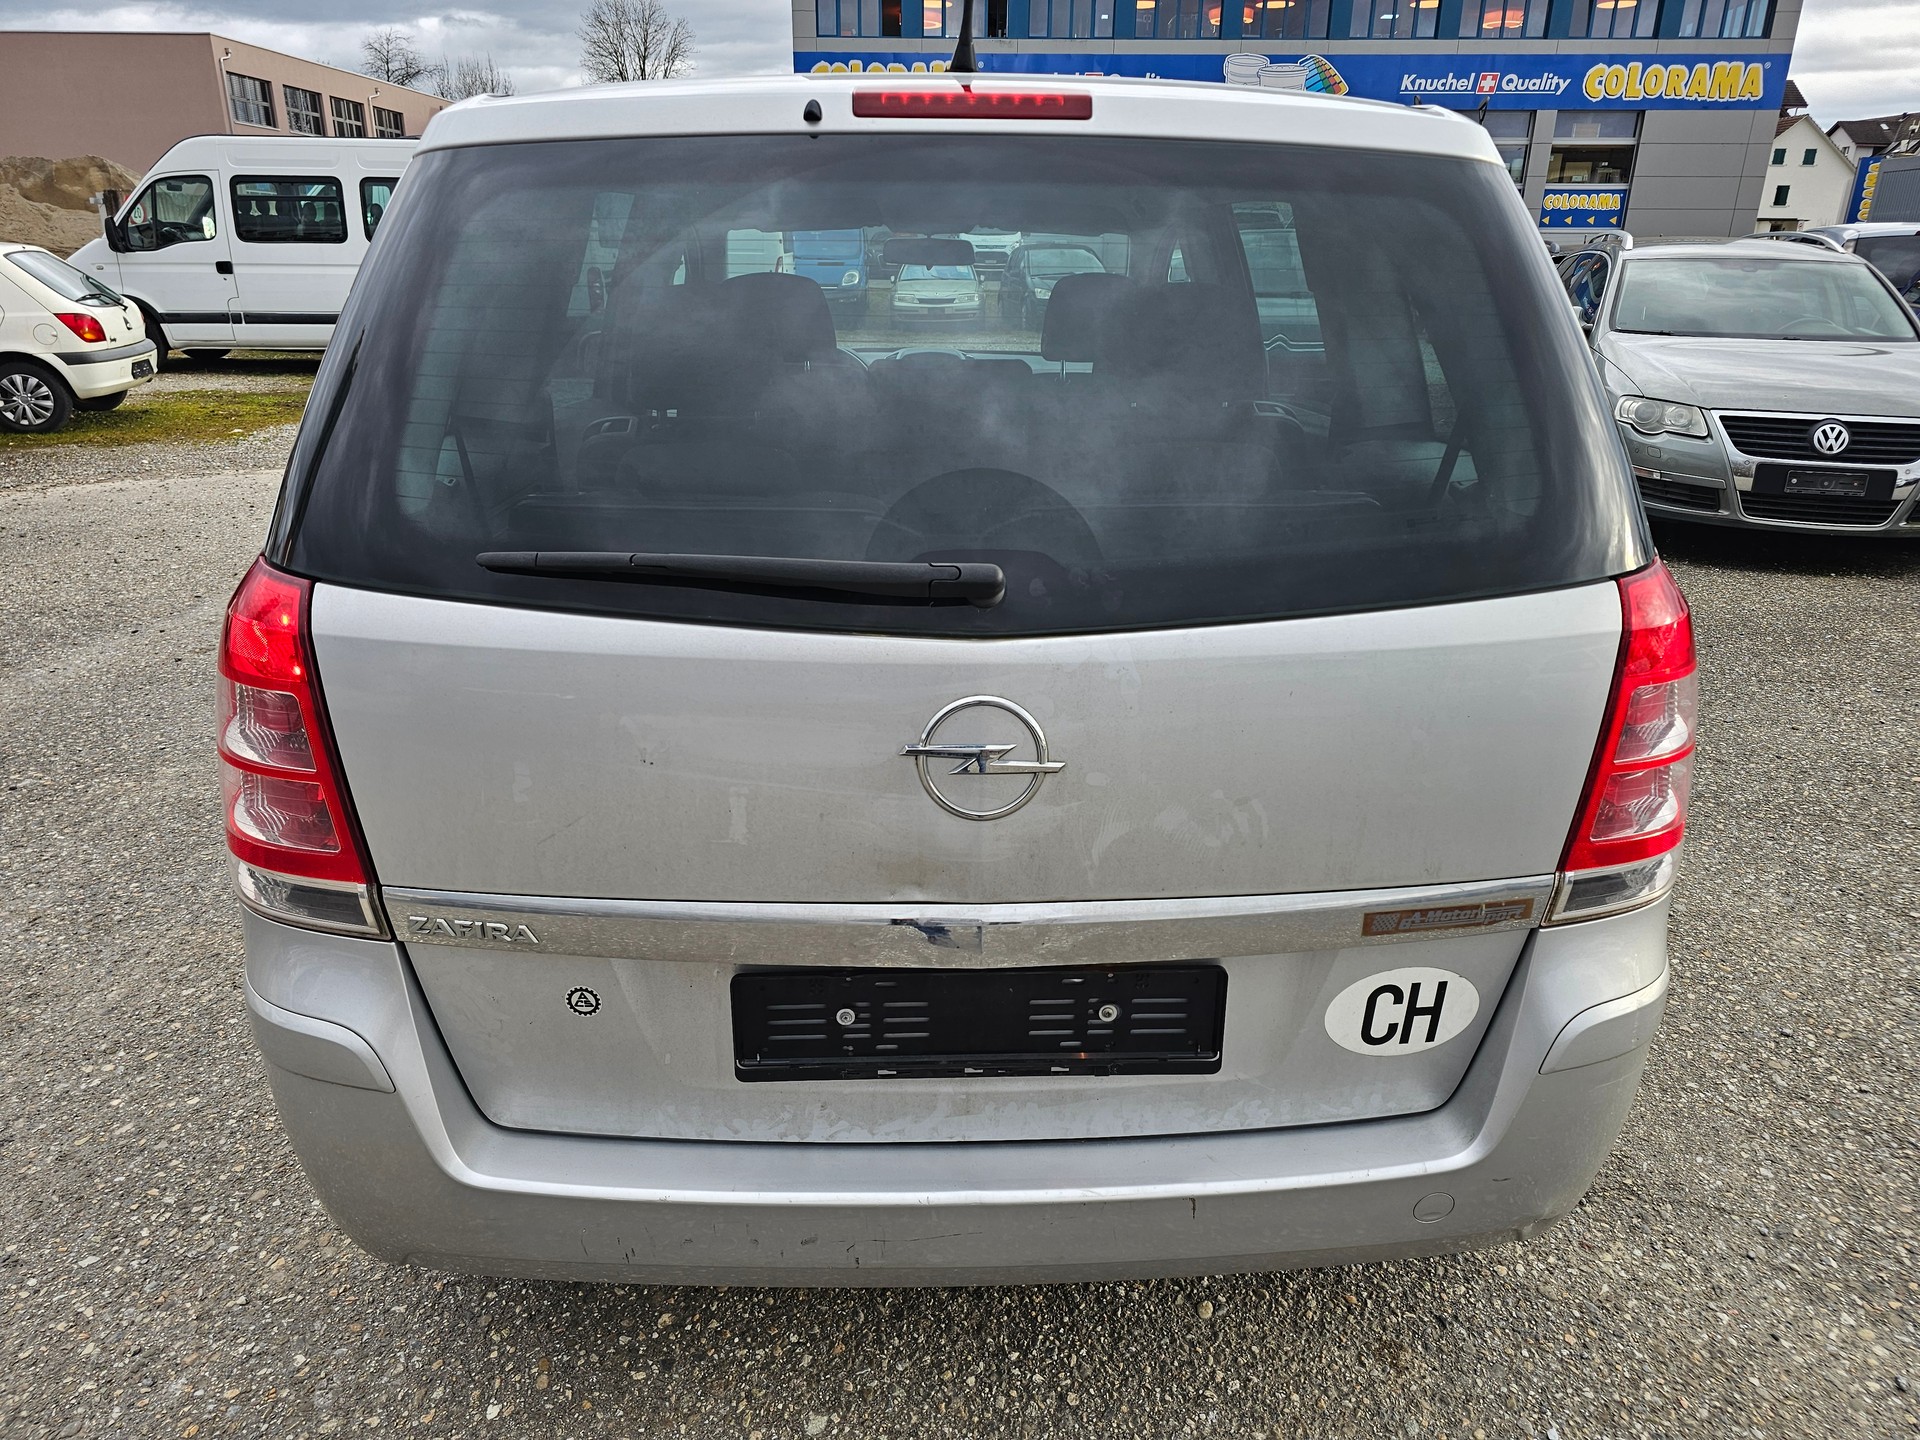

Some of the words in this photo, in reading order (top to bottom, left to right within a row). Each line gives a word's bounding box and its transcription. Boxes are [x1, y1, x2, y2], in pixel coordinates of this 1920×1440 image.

[1400, 72, 1476, 91] Knuchel
[1501, 72, 1571, 95] Quality
[1583, 61, 1764, 102] COLORAMA
[1543, 193, 1621, 210] COLORAMA
[408, 915, 541, 944] ZAFIRA
[1361, 981, 1448, 1046] CH
